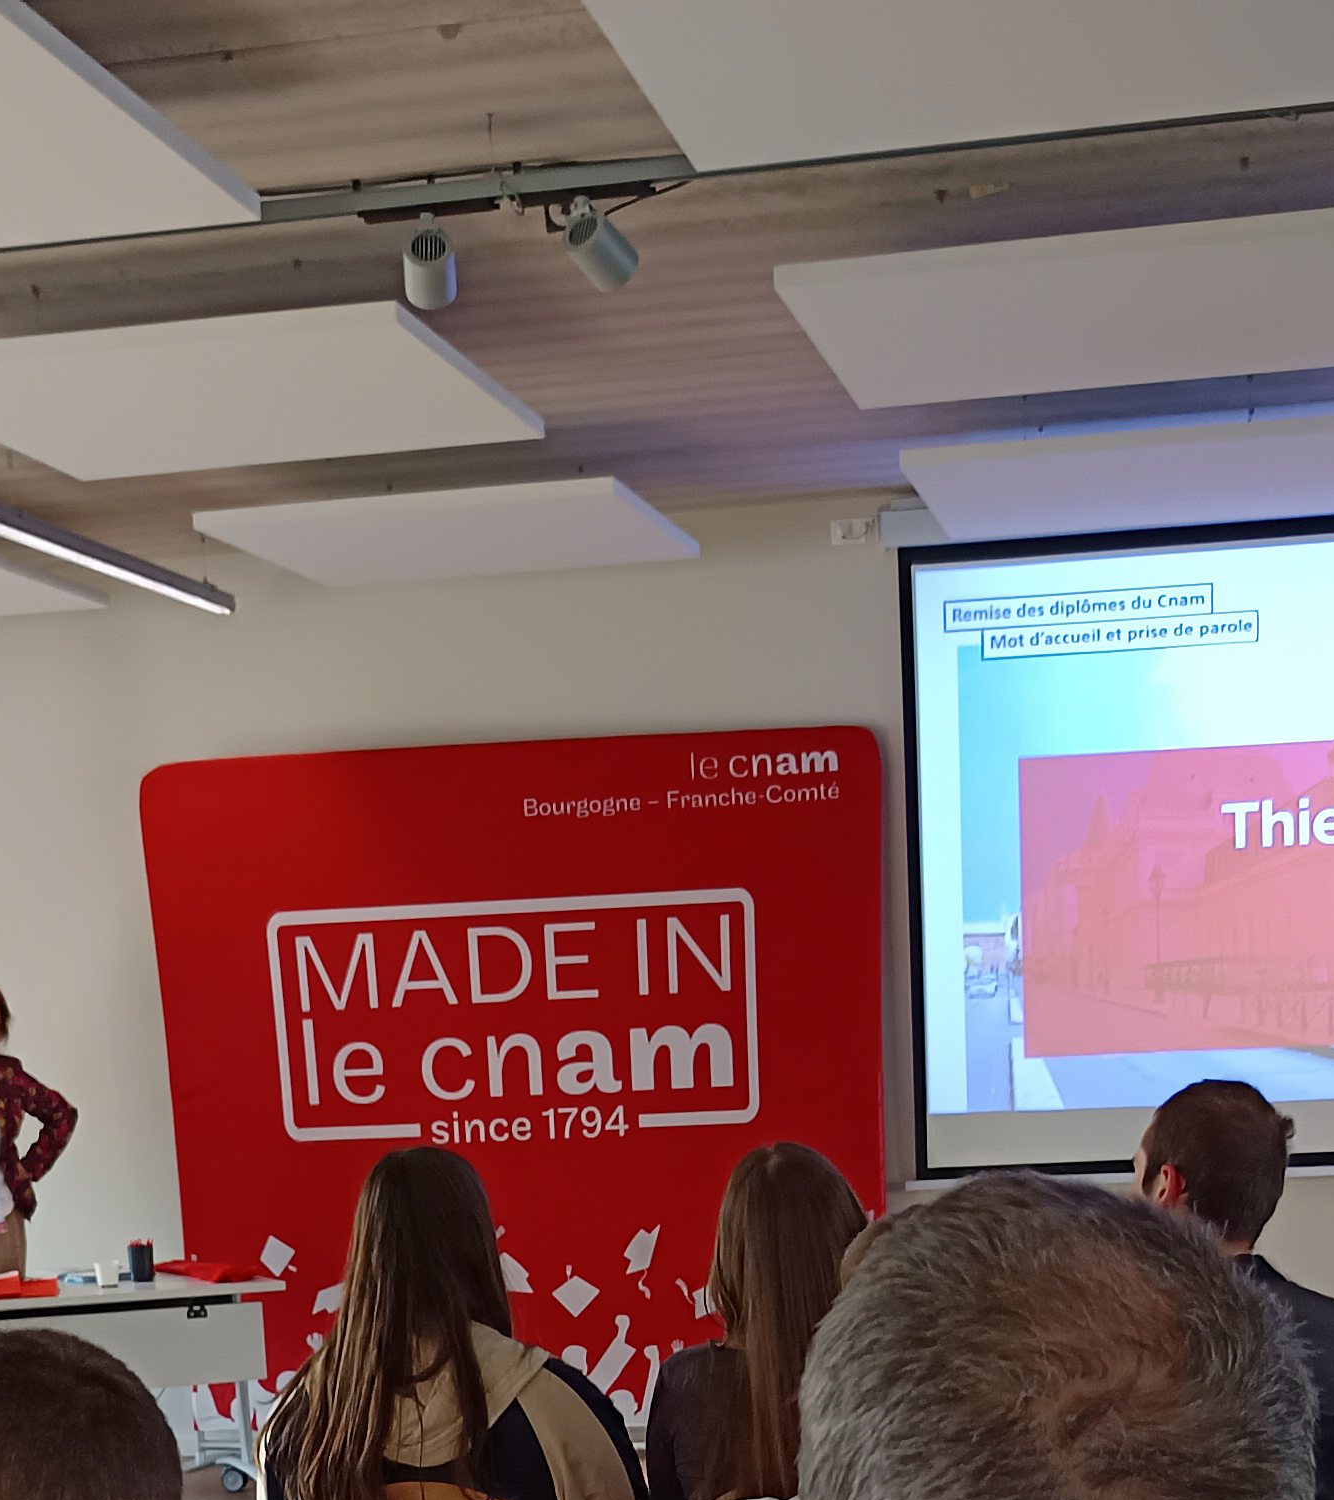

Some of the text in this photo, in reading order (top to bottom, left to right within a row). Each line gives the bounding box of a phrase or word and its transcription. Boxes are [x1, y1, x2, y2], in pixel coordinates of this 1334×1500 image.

[952, 592, 1205, 623] Remise des diplômes du Cnam
[990, 634, 1024, 650] Mot
[1106, 629, 1121, 641] et
[1128, 625, 1168, 643] prise
[1173, 621, 1193, 636] de
[1200, 618, 1253, 638] parole
[690, 749, 839, 780] le cnam
[523, 797, 641, 818] Bourgogne
[666, 780, 839, 809] Franche-Comté
[294, 914, 731, 1013] MADE IN
[302, 1018, 734, 1106] le cnam
[431, 1105, 629, 1145] since 1794
